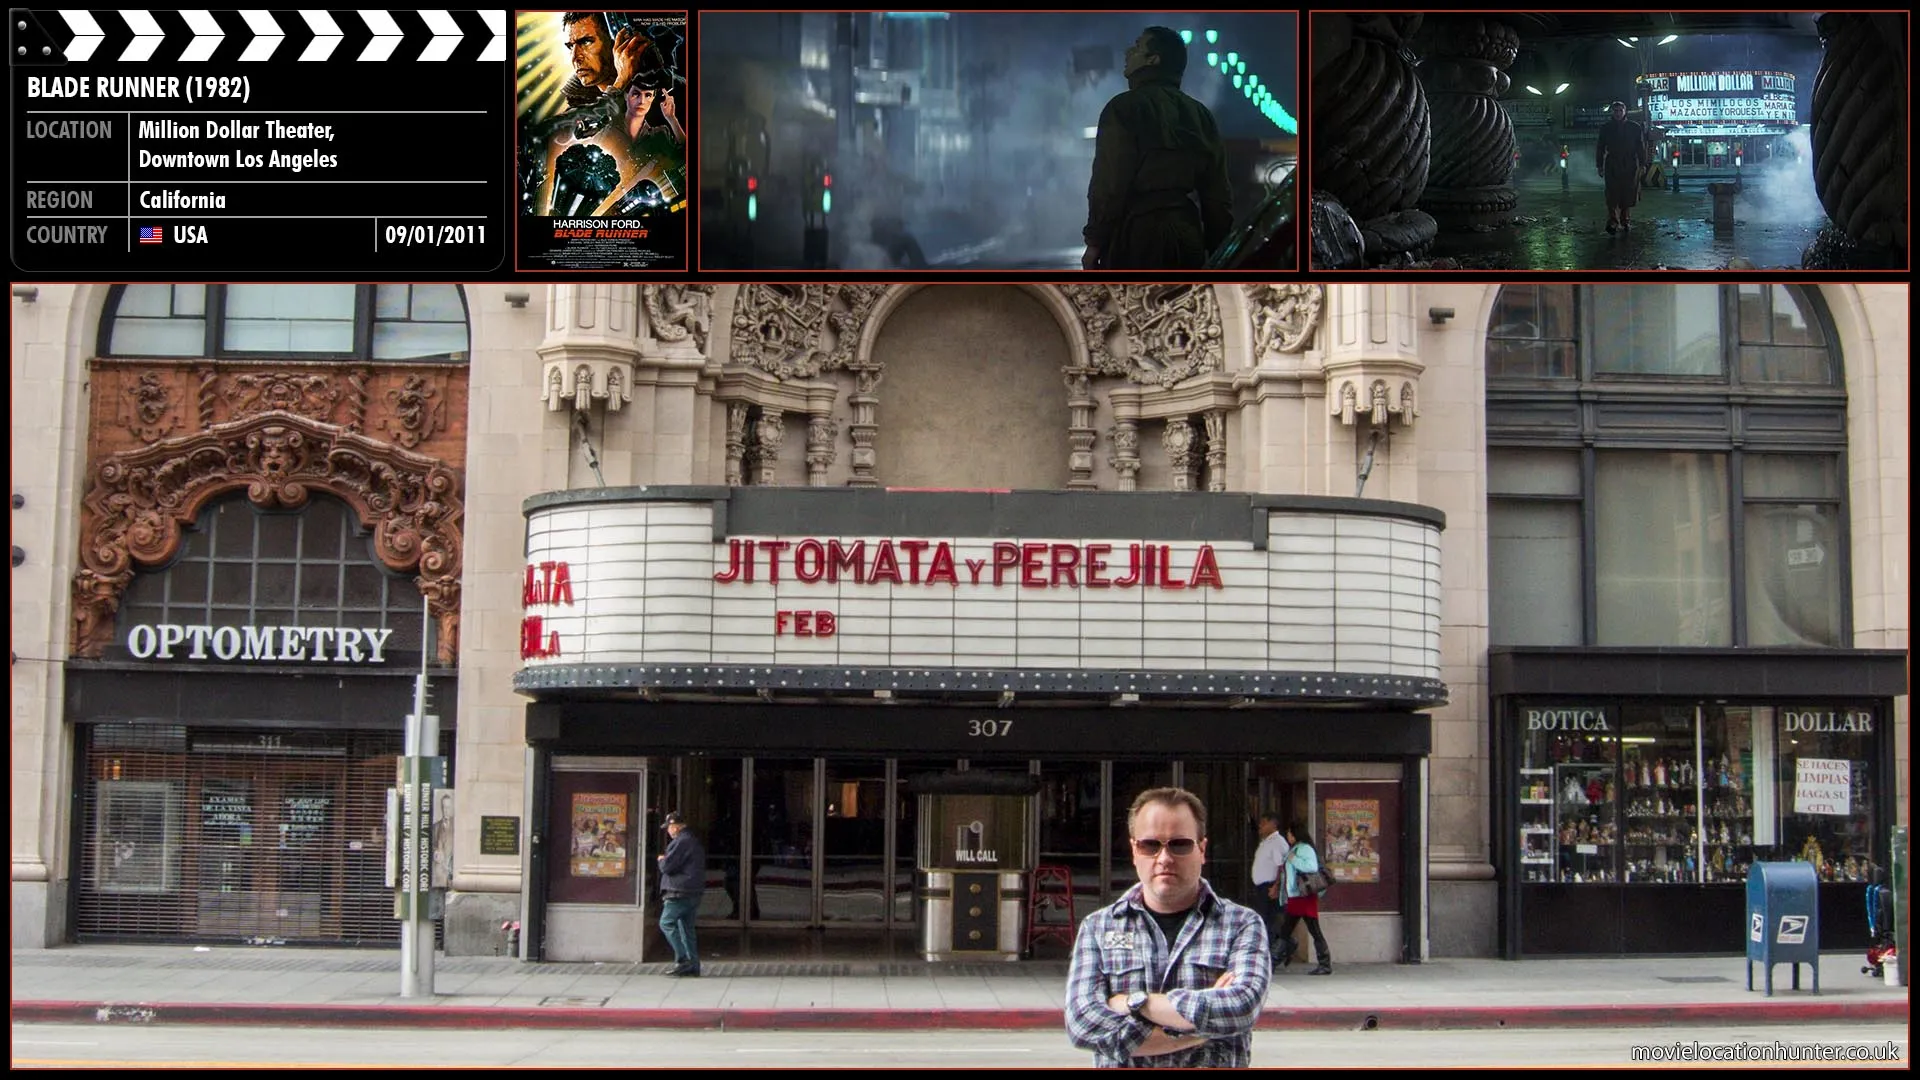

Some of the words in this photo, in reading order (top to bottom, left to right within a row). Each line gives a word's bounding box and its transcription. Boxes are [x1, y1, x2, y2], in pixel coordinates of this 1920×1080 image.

[1677, 75, 1716, 92] MILLION
[1718, 73, 1753, 91] DOLLAR
[1672, 99, 1692, 107] LOS
[553, 219, 608, 229] HARRISON
[554, 229, 593, 238] BLADE
[596, 229, 648, 238] RUNNER
[716, 539, 958, 586] JITOMATA
[966, 559, 985, 584] Y
[993, 542, 1223, 590] PEREJILA
[776, 610, 836, 637] FEB
[128, 624, 393, 663] OPTOMETRY
[968, 719, 1013, 737] 307
[1527, 710, 1609, 731] BOTICA
[1784, 711, 1873, 732] DOLLAR
[259, 735, 281, 748] 311
[1797, 760, 1809, 769] SE
[1812, 760, 1848, 770] HACEN
[1797, 772, 1849, 785] LIMPIAS
[421, 783, 430, 812] BUNKER
[1797, 789, 1830, 799] HAGA
[1832, 790, 1847, 800] SU
[1808, 803, 1835, 813] CITA
[421, 814, 430, 829] HILL
[420, 838, 429, 873] HISTORIC
[955, 849, 976, 862] WILL
[976, 849, 998, 862] CALL
[419, 875, 429, 892] CORE
